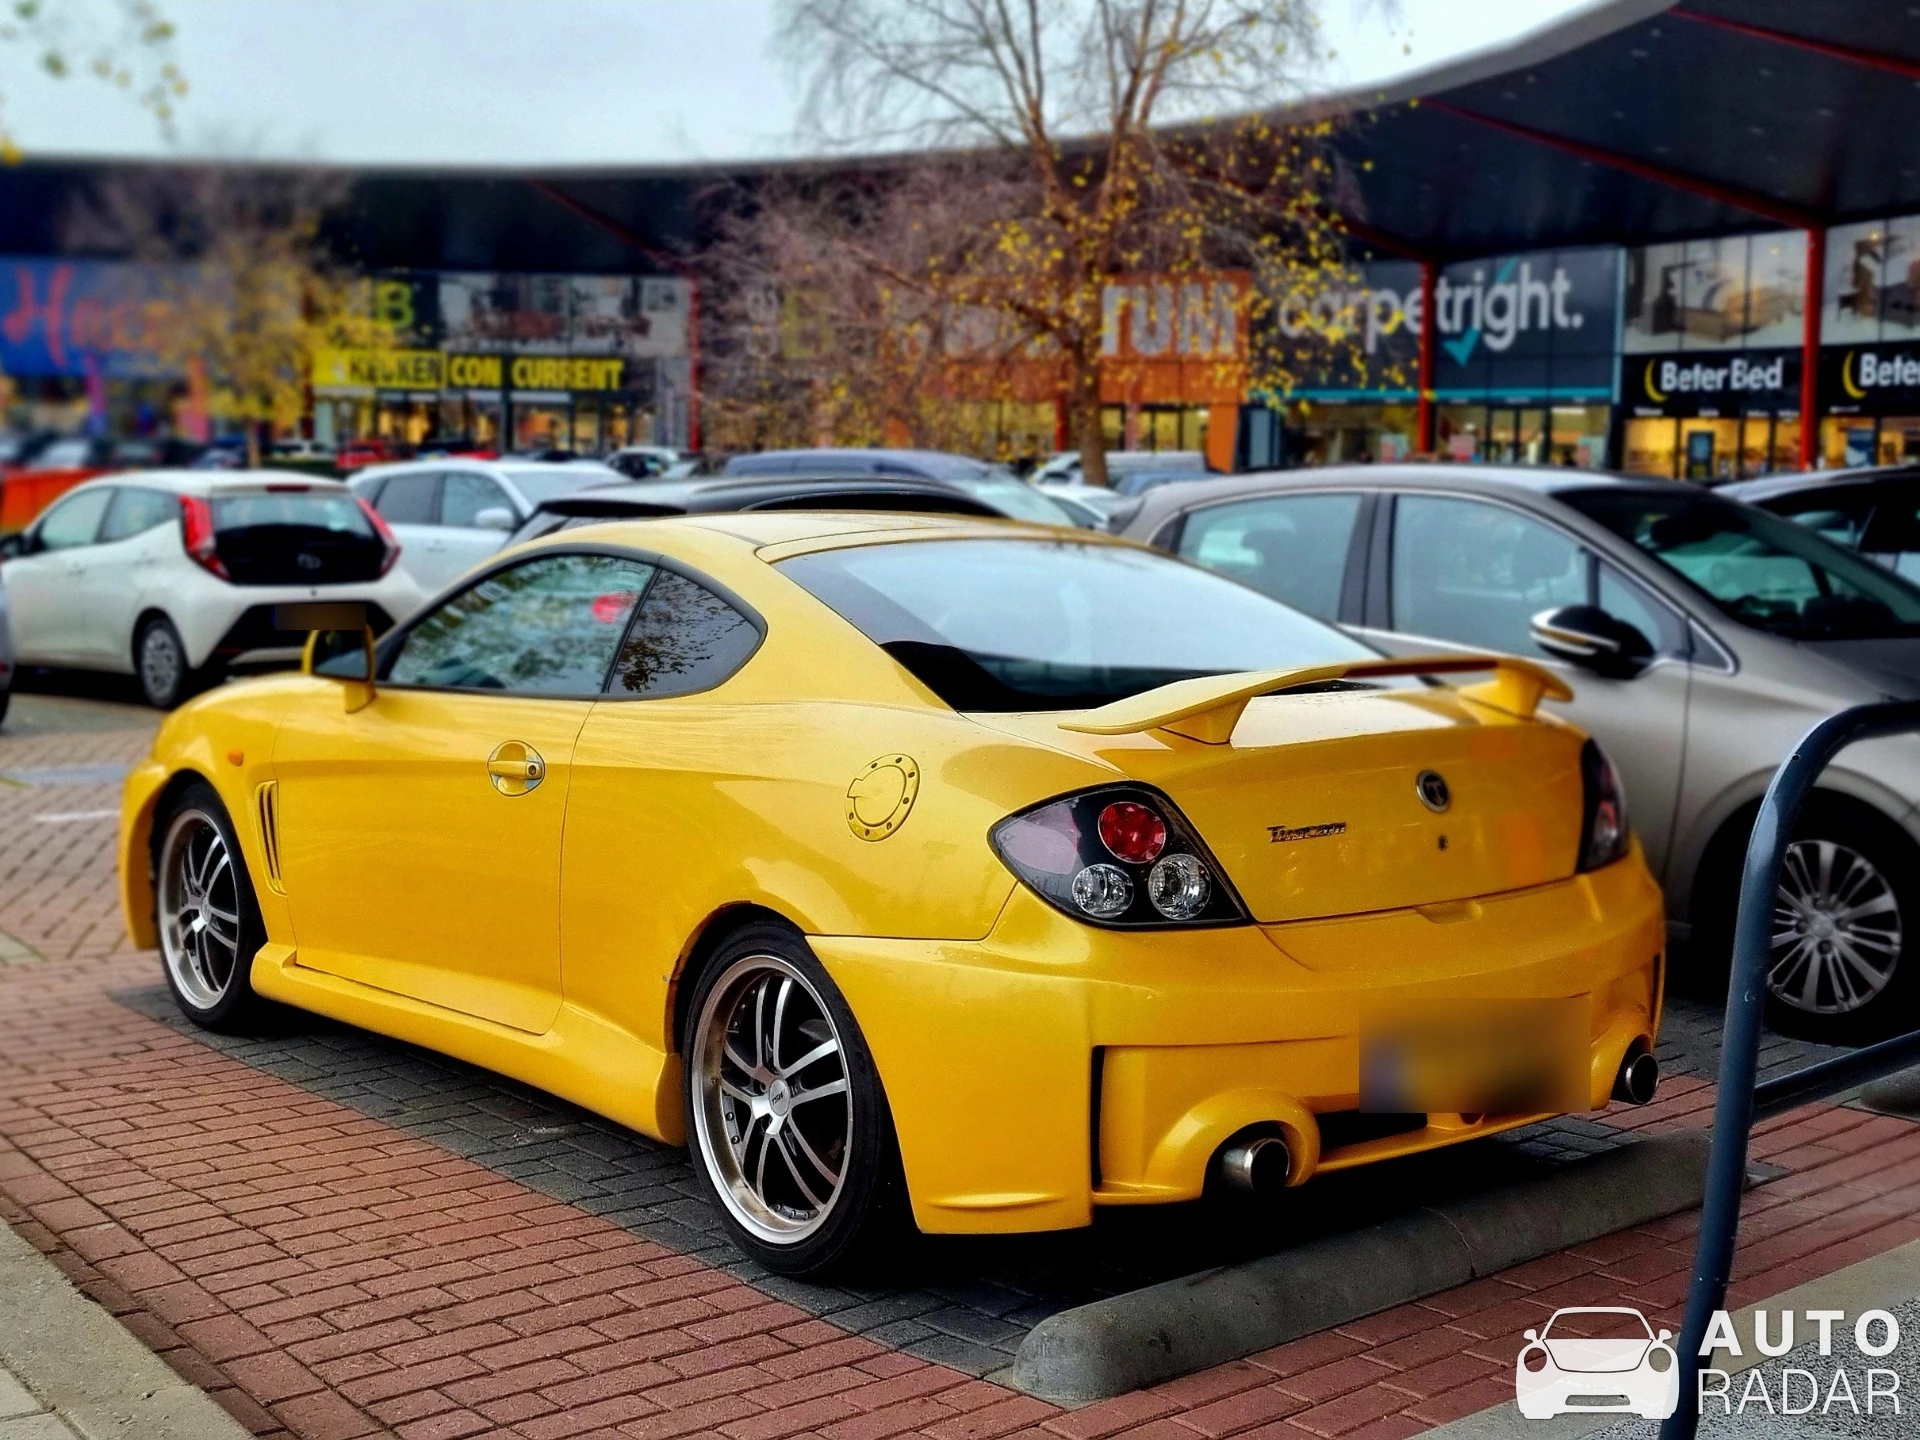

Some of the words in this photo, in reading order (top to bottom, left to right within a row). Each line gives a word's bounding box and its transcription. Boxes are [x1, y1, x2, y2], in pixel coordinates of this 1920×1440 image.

[511, 356, 625, 390] CURRENT
[1661, 360, 1729, 393] Beter
[1730, 357, 1784, 390] Bed
[1860, 352, 1920, 387] Bete
